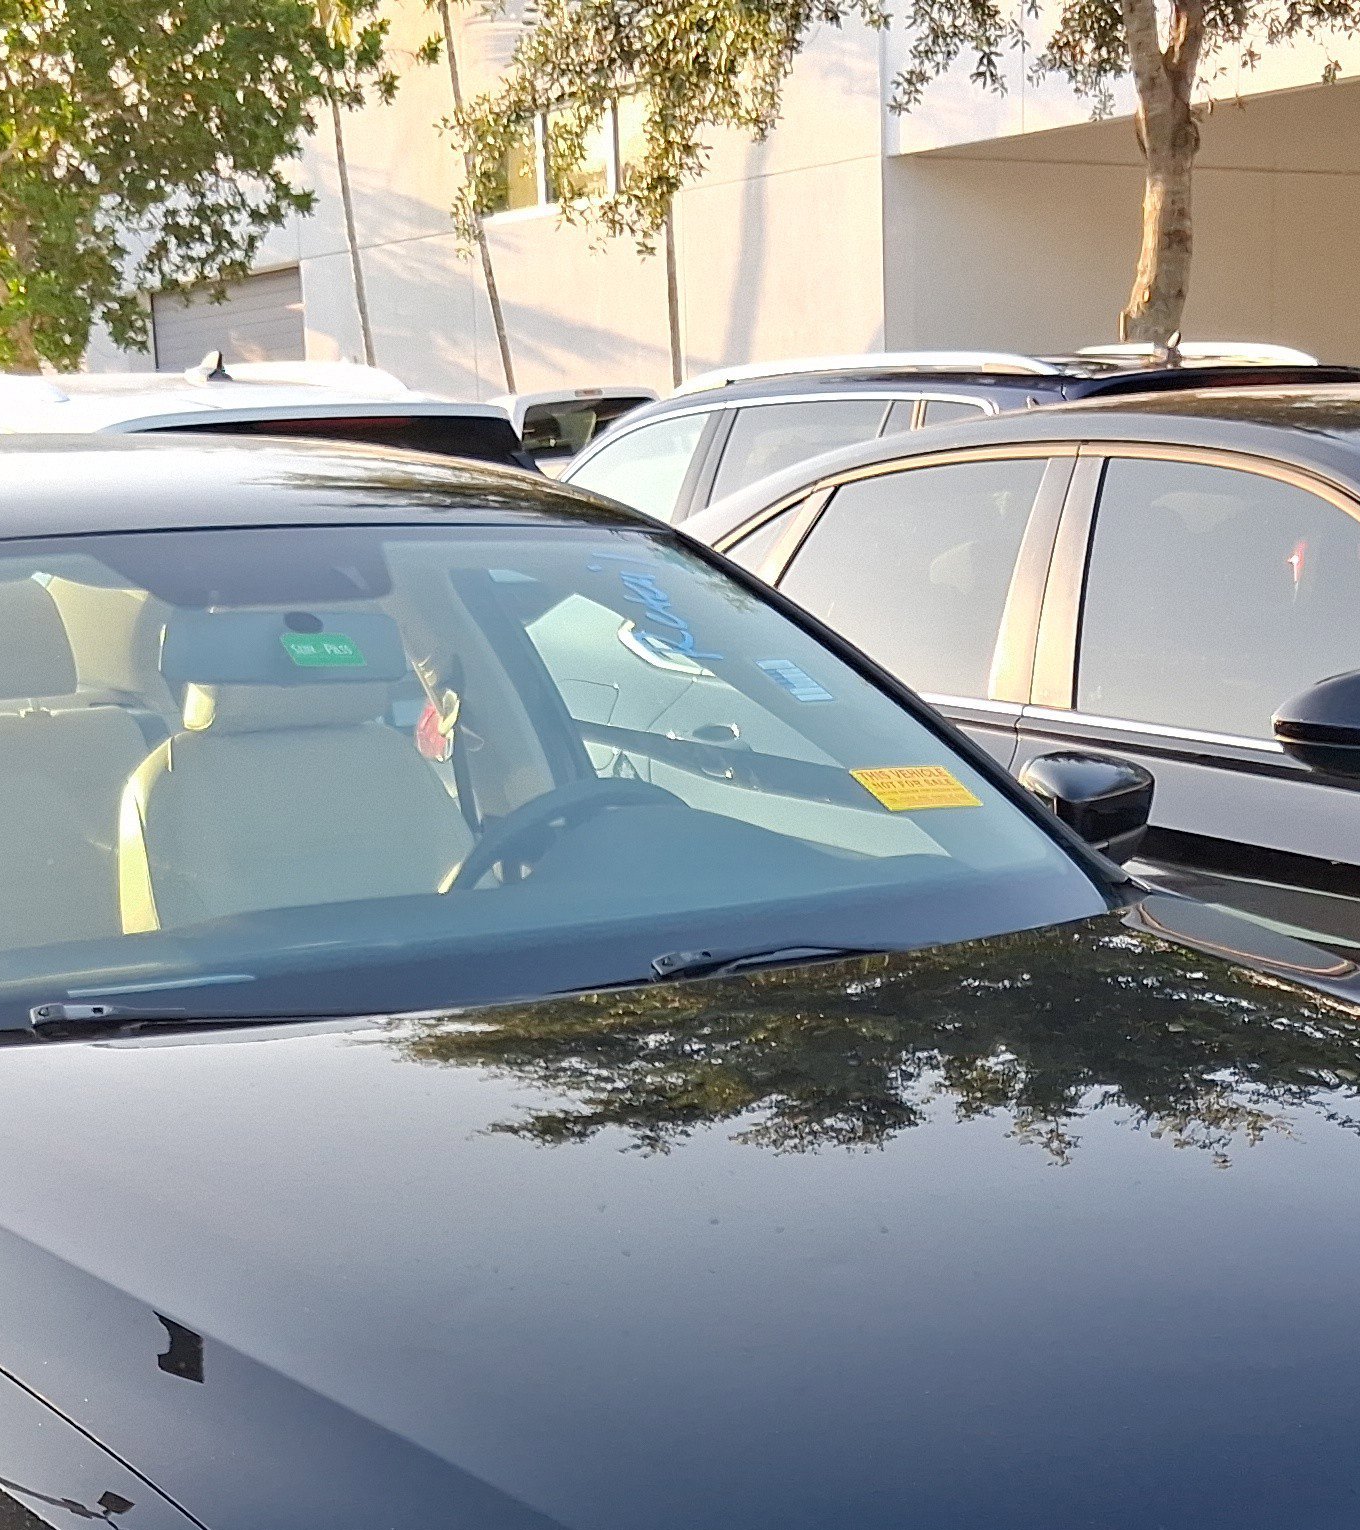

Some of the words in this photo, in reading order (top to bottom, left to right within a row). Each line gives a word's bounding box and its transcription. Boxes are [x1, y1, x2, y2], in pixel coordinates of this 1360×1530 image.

[857, 770, 892, 781] THIS
[890, 768, 949, 779] VEHICLE
[871, 781, 897, 790] NOT
[897, 780, 924, 788] FOR
